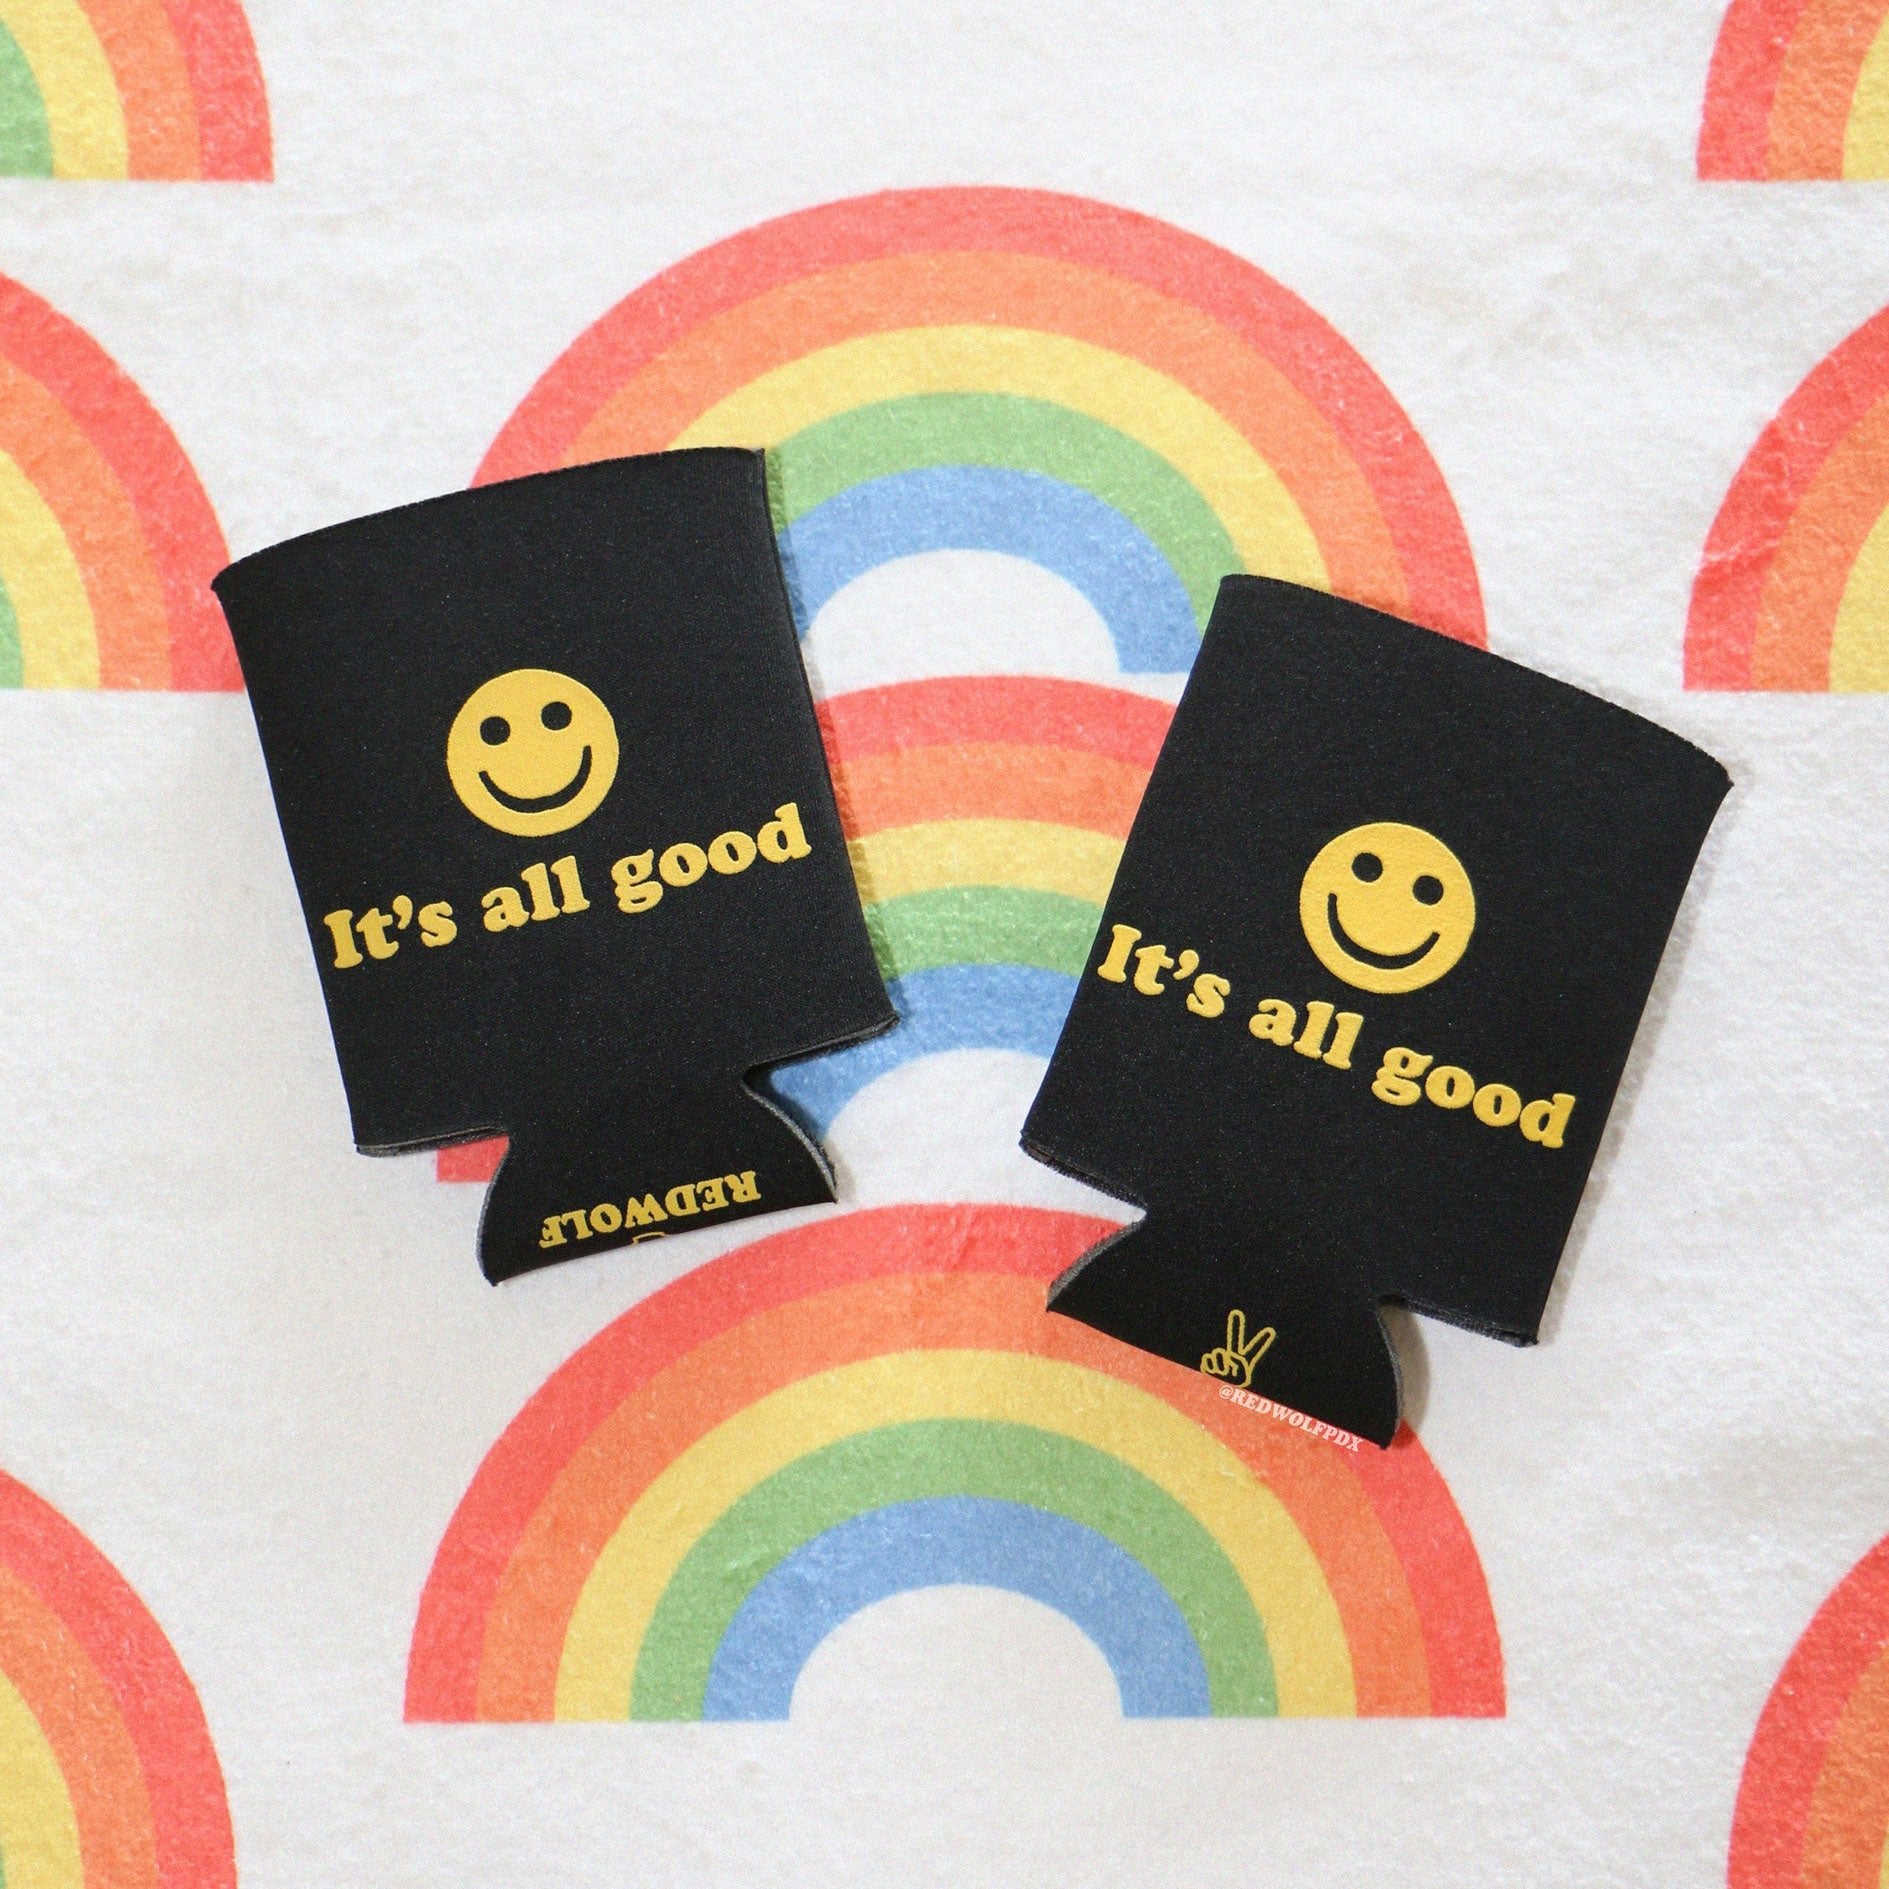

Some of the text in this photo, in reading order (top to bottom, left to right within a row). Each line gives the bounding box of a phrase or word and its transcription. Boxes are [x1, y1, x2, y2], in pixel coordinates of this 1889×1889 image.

[324, 802, 811, 968] It's all good
[1097, 923, 1577, 1149] It's all good
[539, 1171, 761, 1249] REDWOLF
